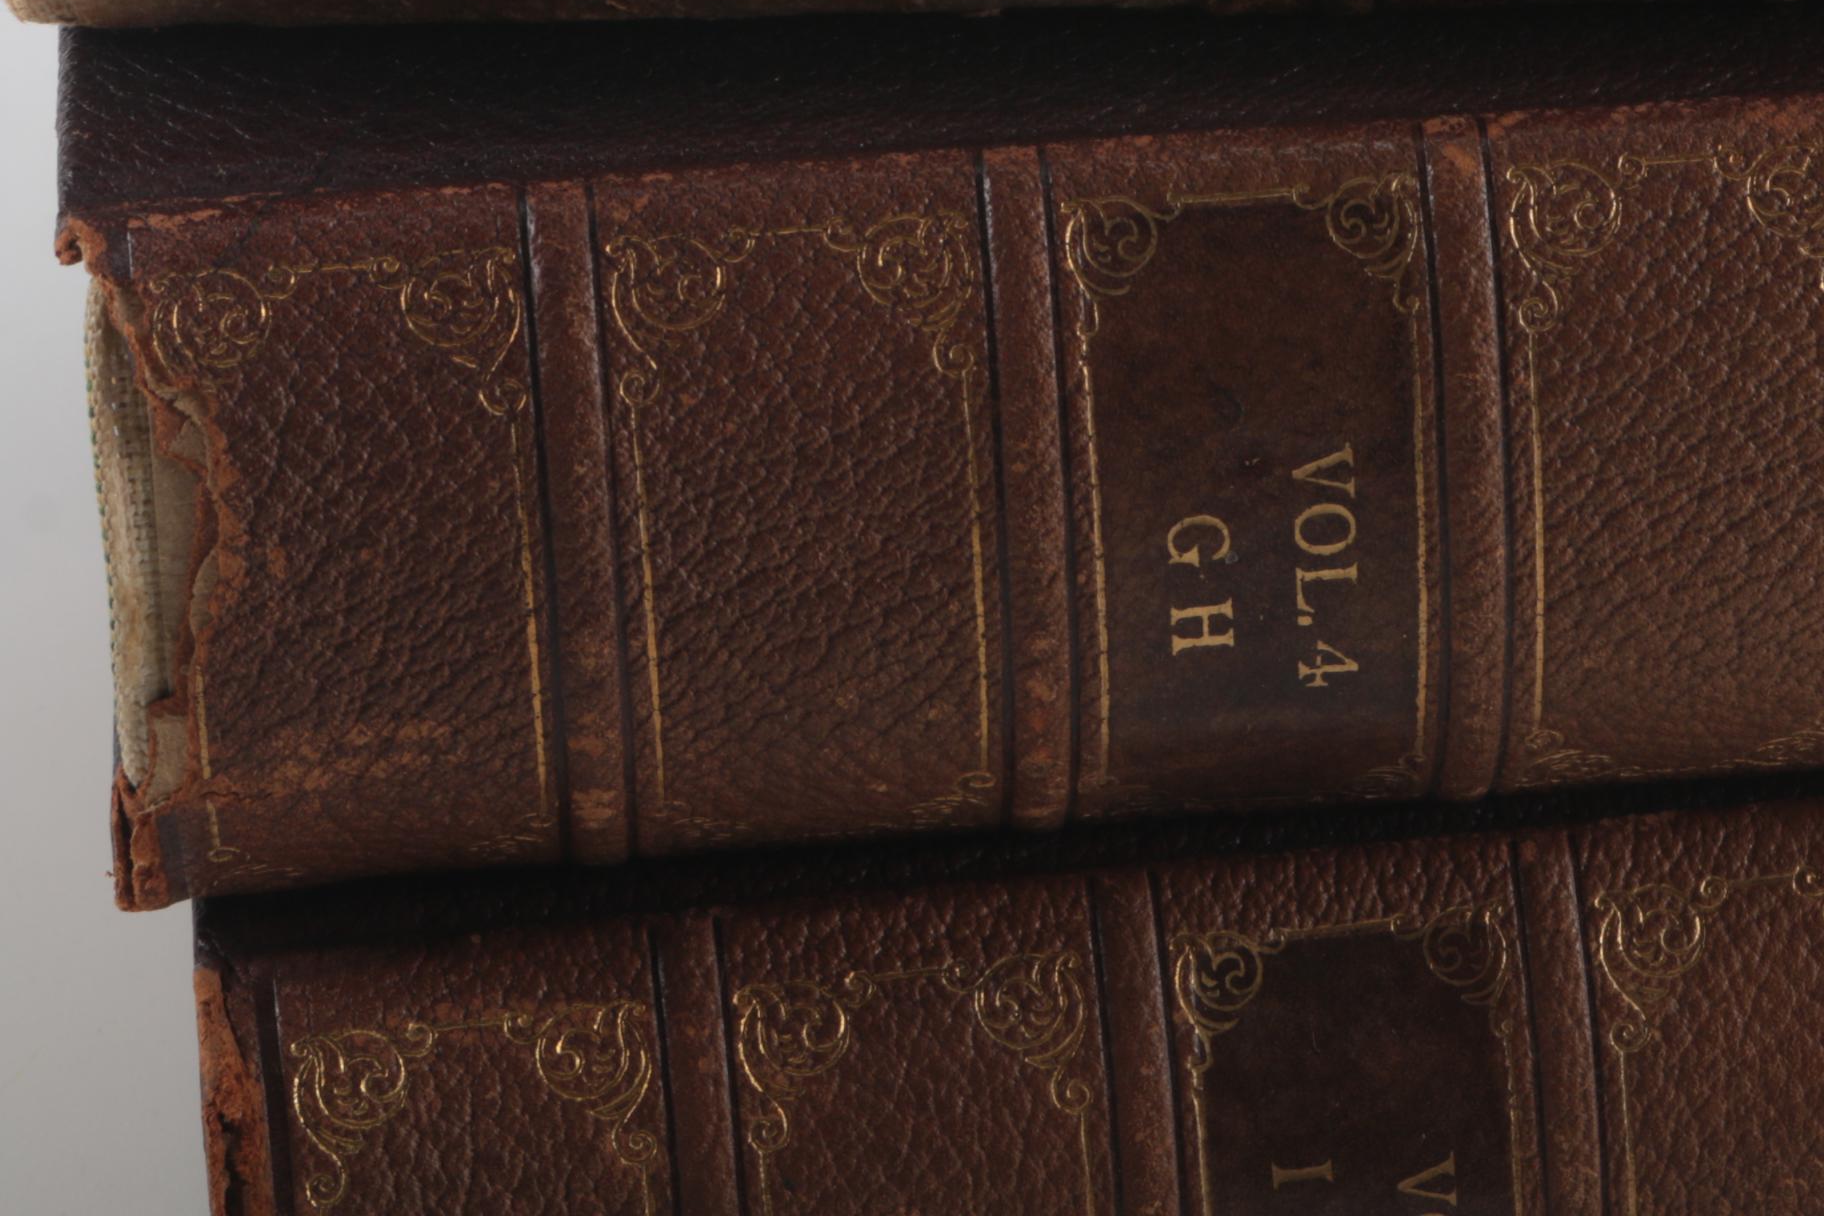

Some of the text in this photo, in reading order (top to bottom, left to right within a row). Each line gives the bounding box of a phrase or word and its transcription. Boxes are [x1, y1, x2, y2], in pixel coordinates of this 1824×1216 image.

[1167, 514, 1234, 655] G H
[1397, 1151, 1457, 1216] V
